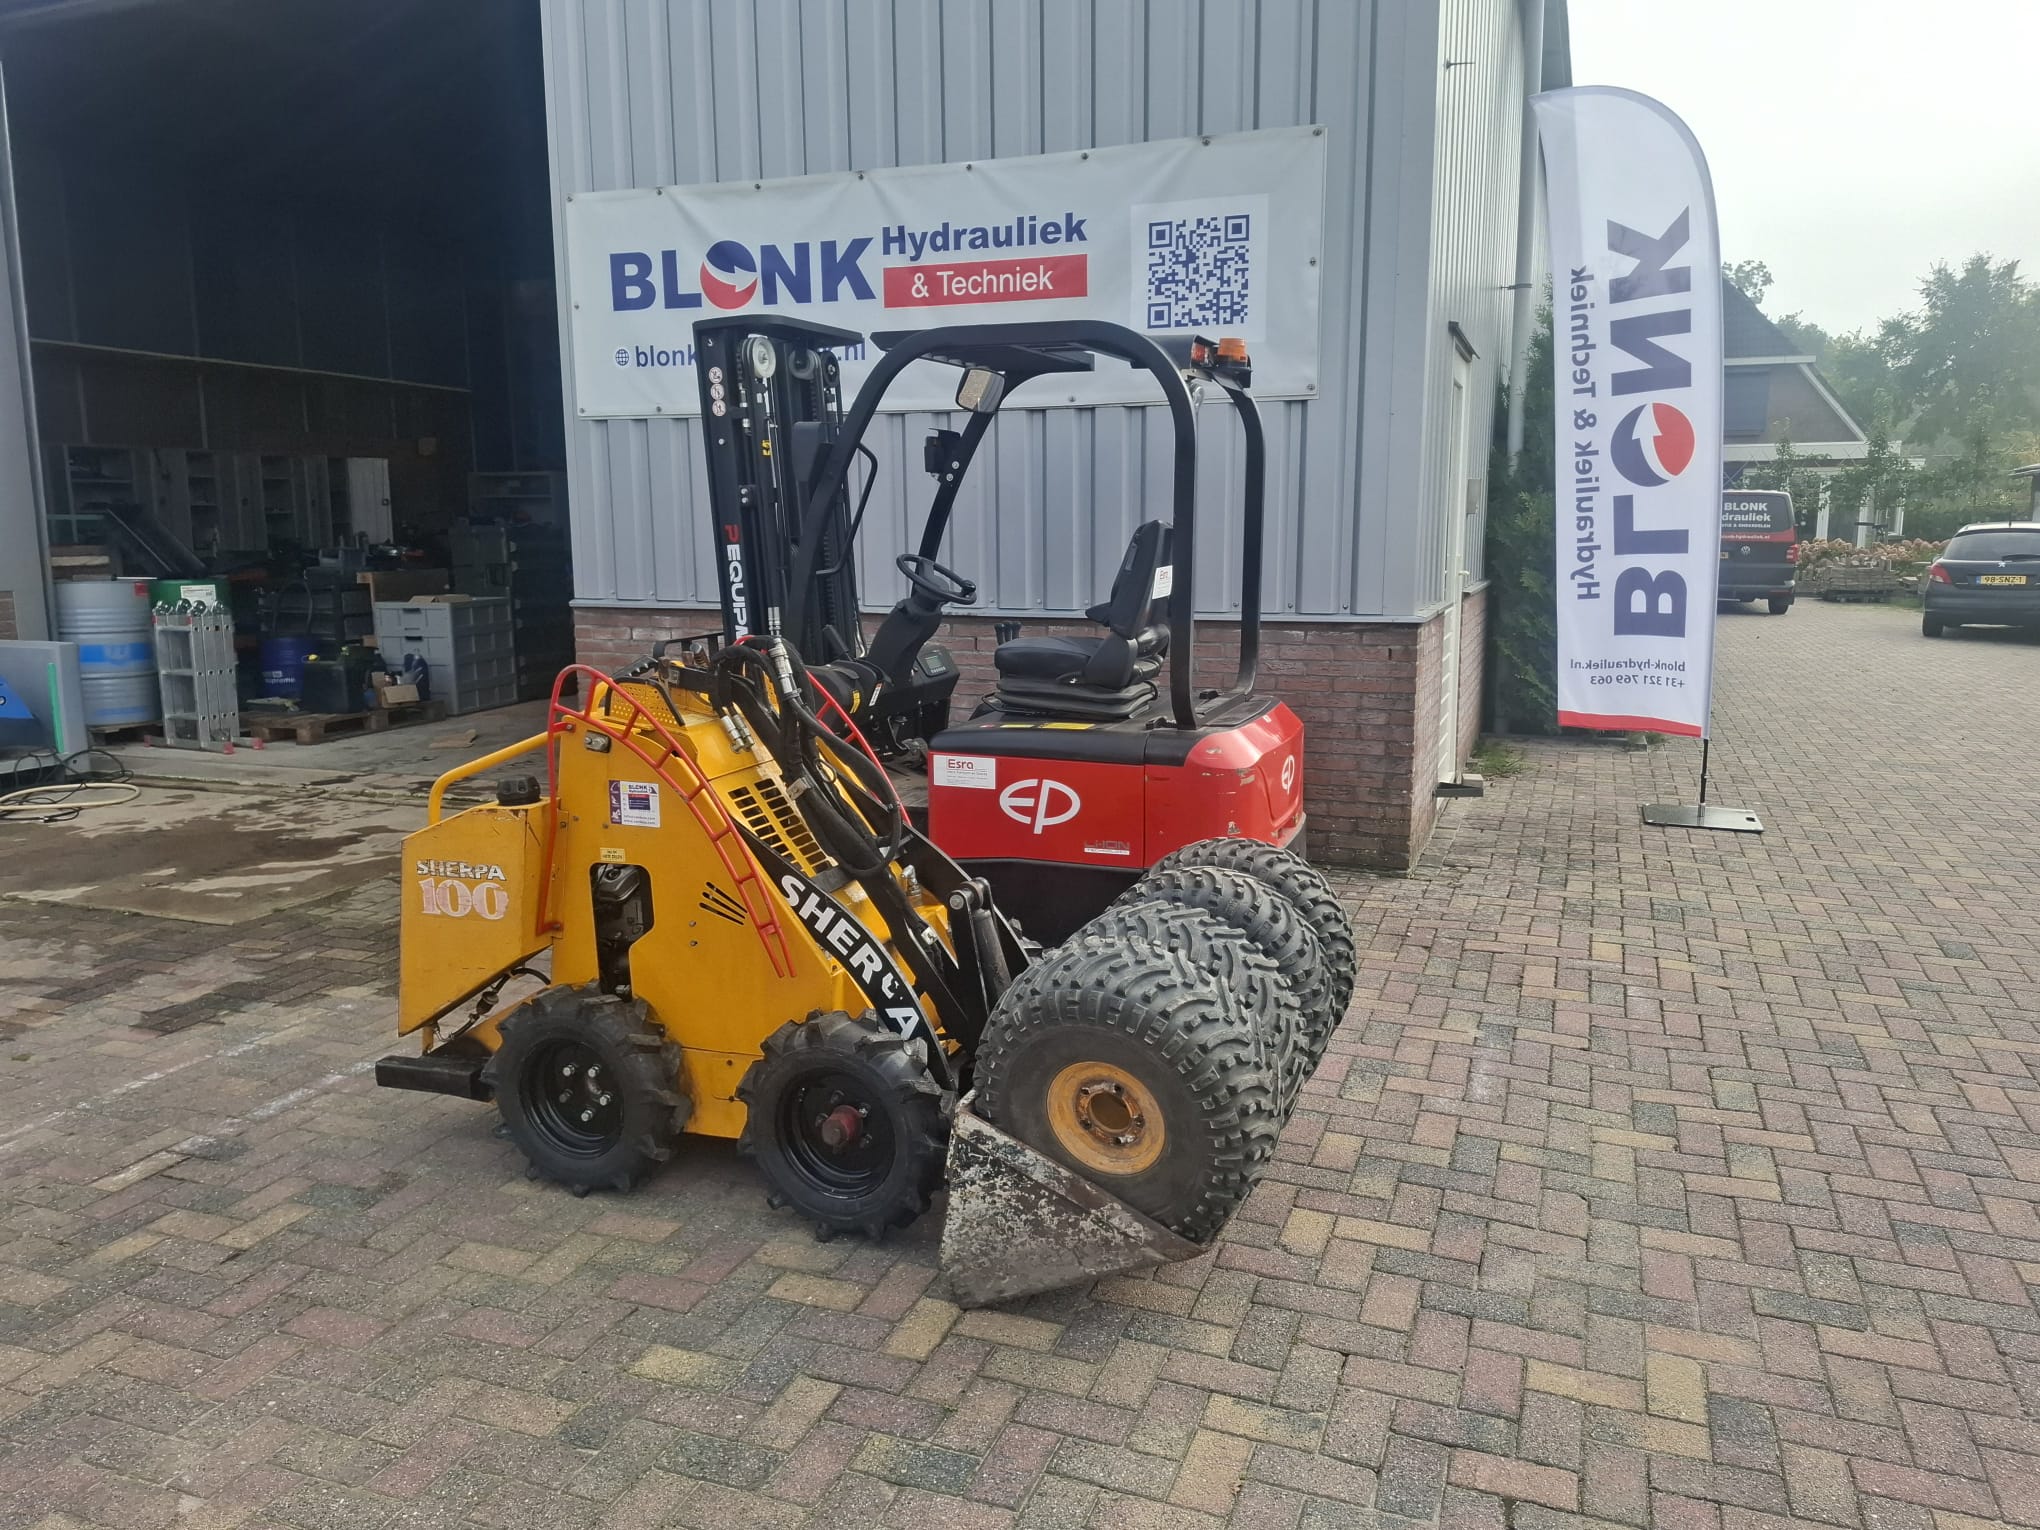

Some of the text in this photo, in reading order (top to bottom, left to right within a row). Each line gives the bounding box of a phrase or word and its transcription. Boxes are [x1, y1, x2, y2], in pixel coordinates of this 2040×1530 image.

[882, 212, 1088, 262] Hydrauliek
[609, 237, 877, 312] BLONK
[911, 265, 1054, 299] & Techniek
[1722, 512, 1771, 522] drauliek
[1724, 502, 1768, 511] BLONK
[948, 759, 974, 770] Esra
[999, 778, 1081, 834] EP
[416, 859, 507, 881] SHERPA
[418, 878, 510, 920] 100
